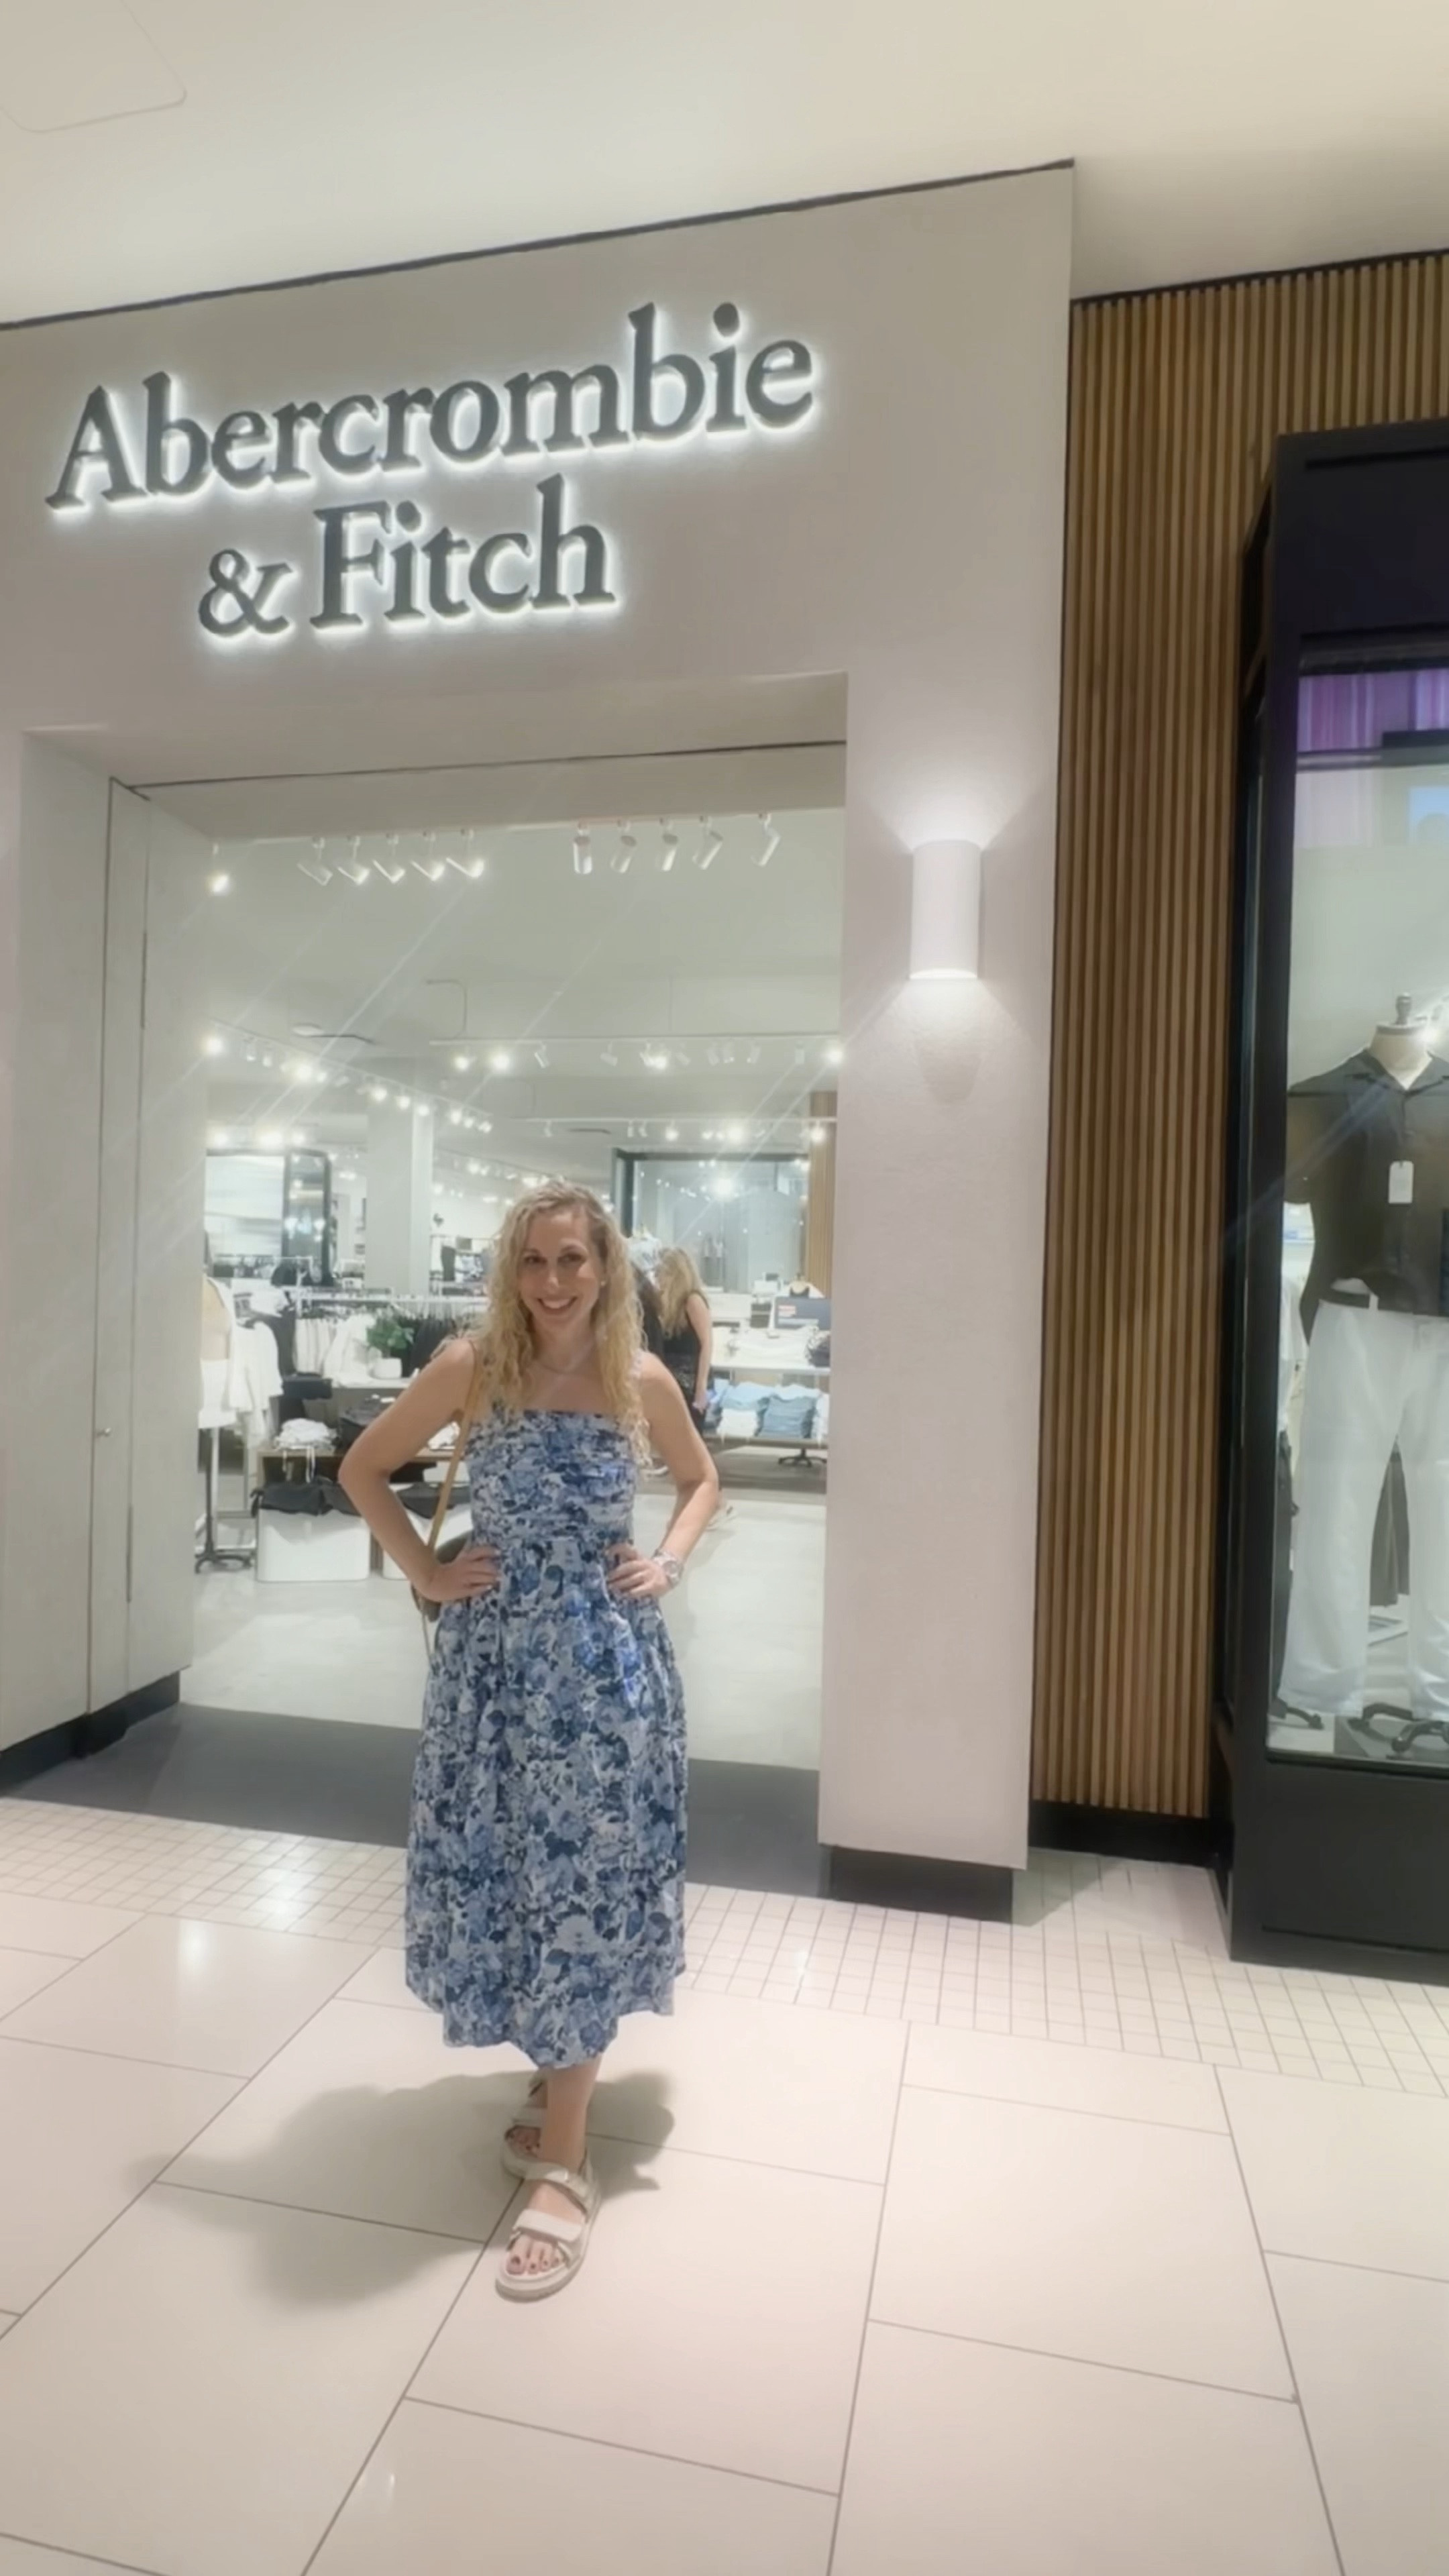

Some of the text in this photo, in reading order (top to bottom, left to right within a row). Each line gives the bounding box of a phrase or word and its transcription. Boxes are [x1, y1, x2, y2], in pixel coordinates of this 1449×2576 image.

[45, 302, 814, 508] Abercrombie
[198, 473, 615, 635] & Fitch
